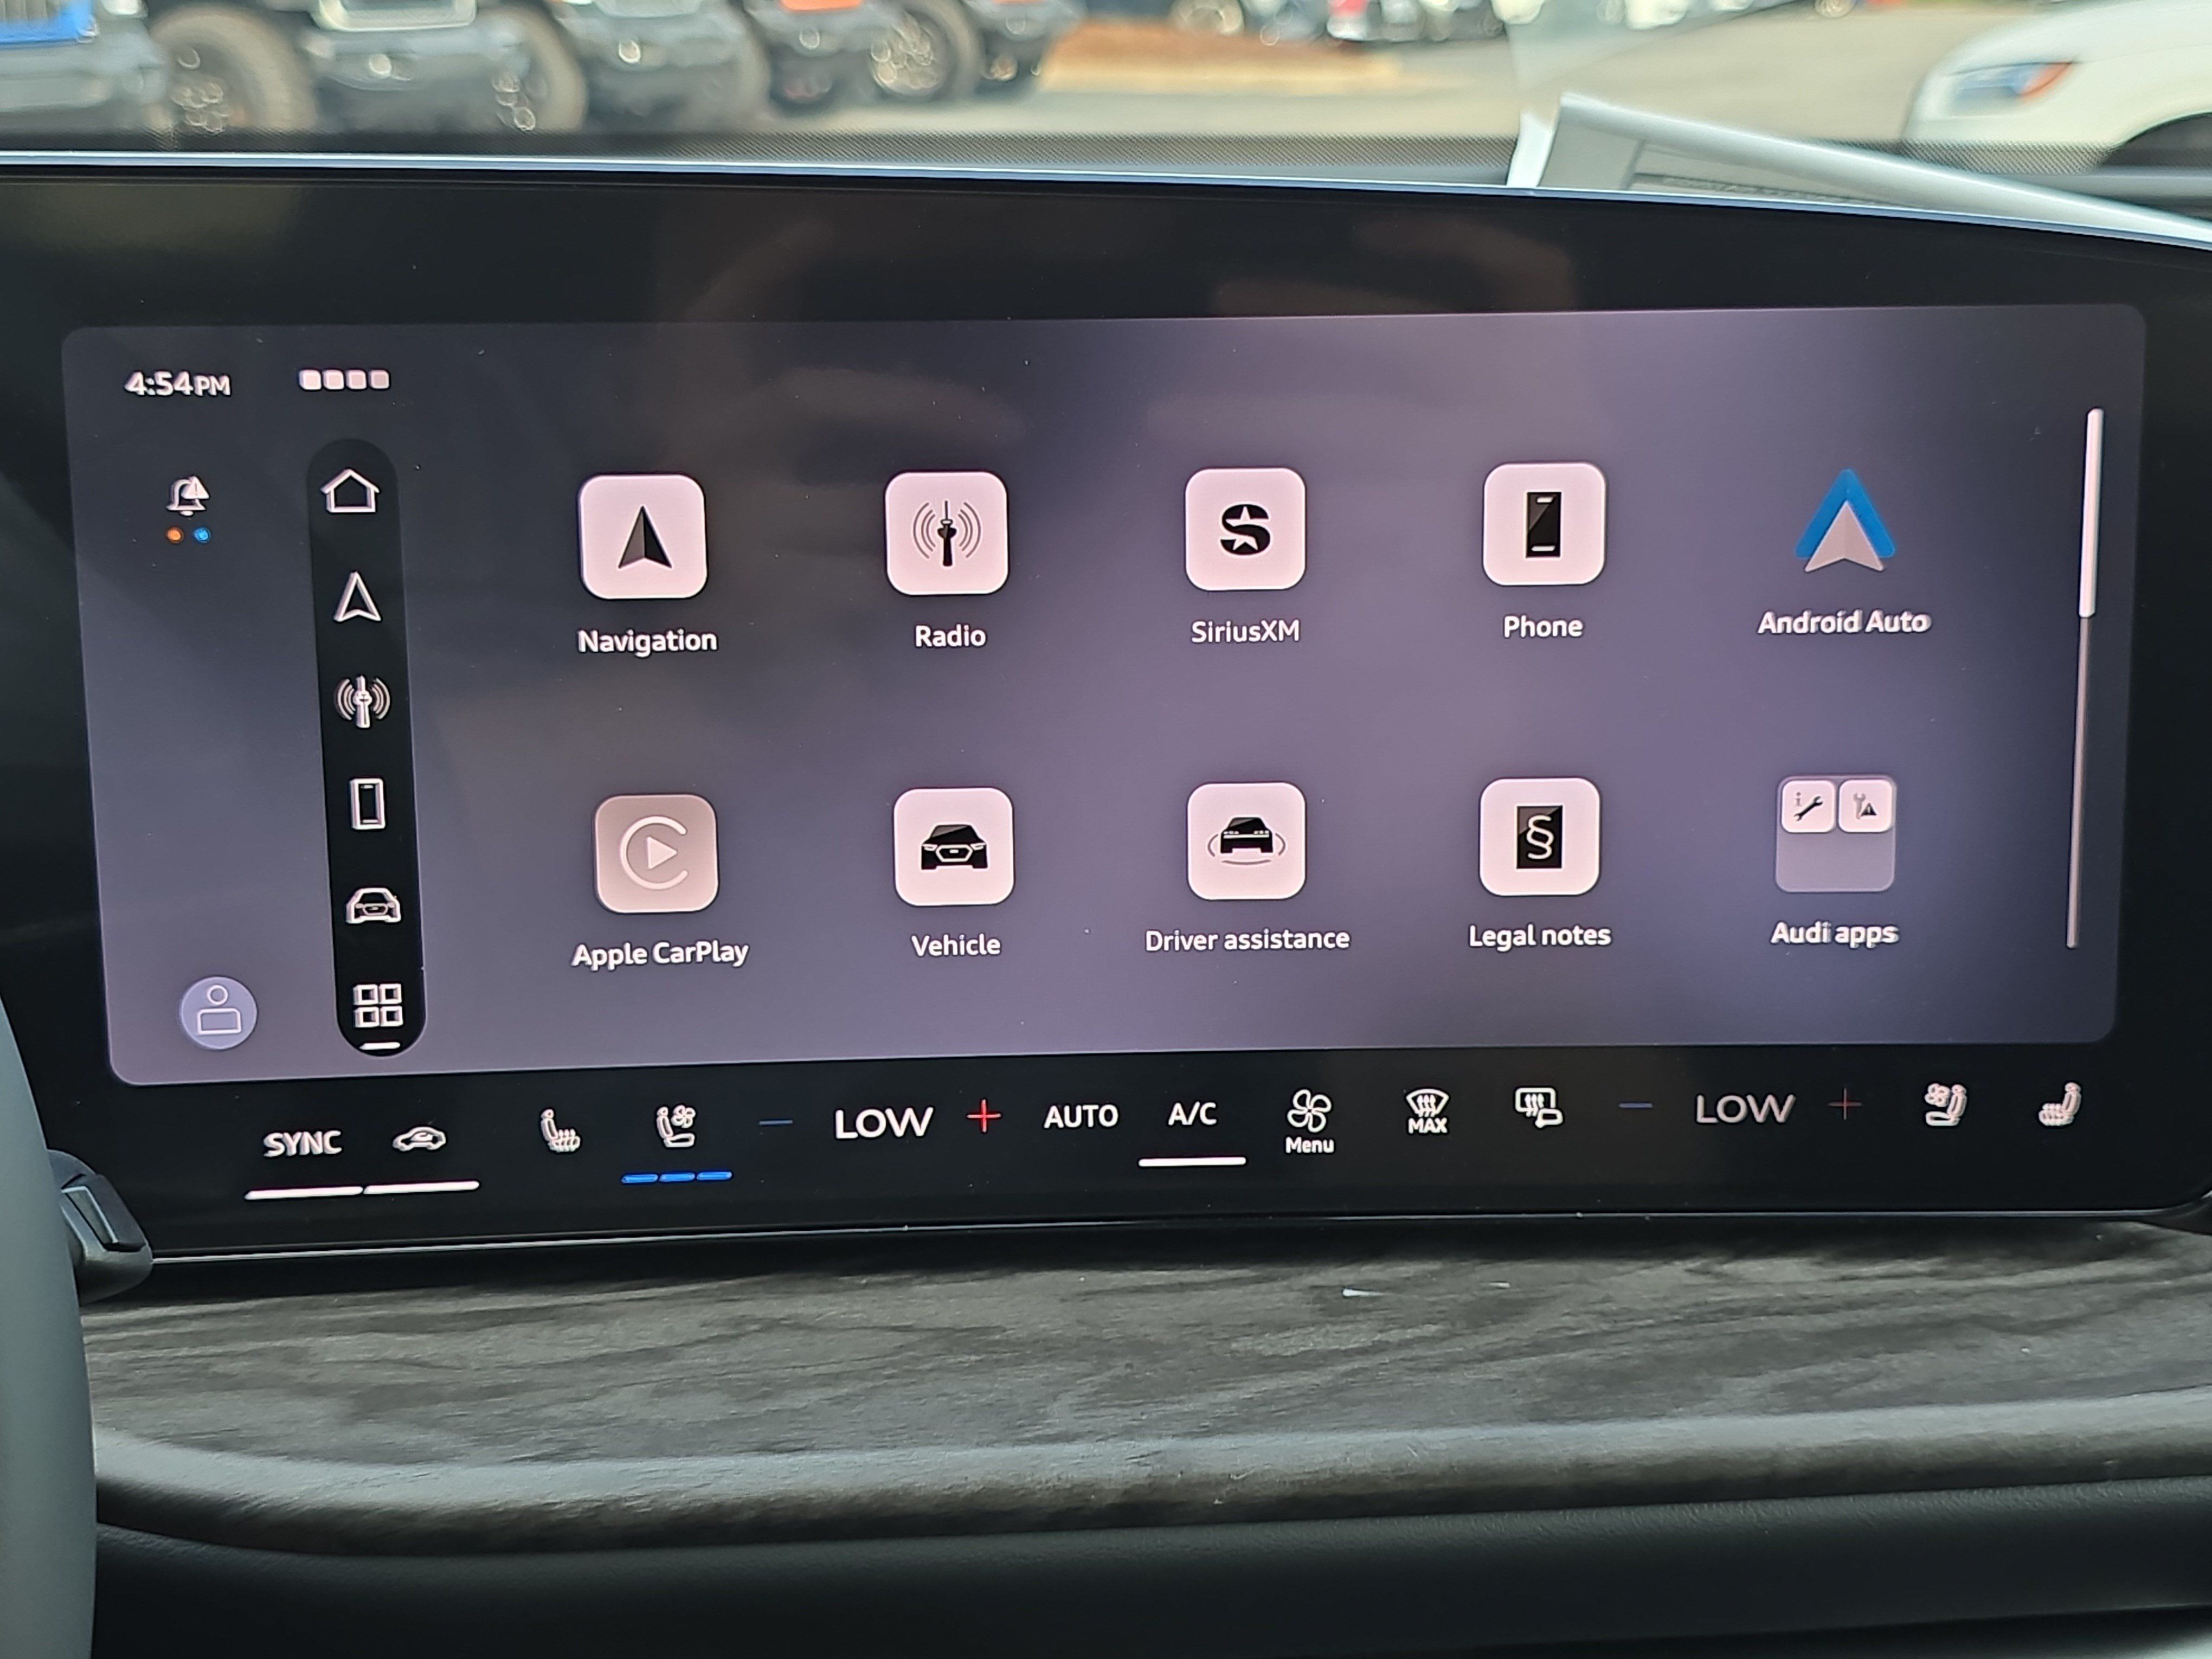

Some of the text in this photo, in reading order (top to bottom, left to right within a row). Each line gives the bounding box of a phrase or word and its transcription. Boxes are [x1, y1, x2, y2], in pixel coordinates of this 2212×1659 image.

[1192, 620, 1300, 642] SiriusXM
[1504, 615, 1583, 638] Phone
[1758, 610, 1931, 633] Android Auto
[578, 629, 717, 658] Navigation
[916, 625, 986, 647] Radio
[911, 933, 1001, 956] Vehicle
[1146, 929, 1350, 951] Driver assistance
[1470, 924, 1611, 952] Legal notes
[1771, 922, 1899, 948] Audi apps
[572, 941, 749, 971] Apple CarPlay
[1044, 1104, 1118, 1129] AUTO
[1168, 1101, 1217, 1126] A/C
[1696, 1095, 1796, 1123] LOW
[835, 1107, 934, 1139] LOW
[1409, 1118, 1448, 1134] MAX
[263, 1130, 343, 1157] SYNC
[1285, 1136, 1334, 1154] Menu
